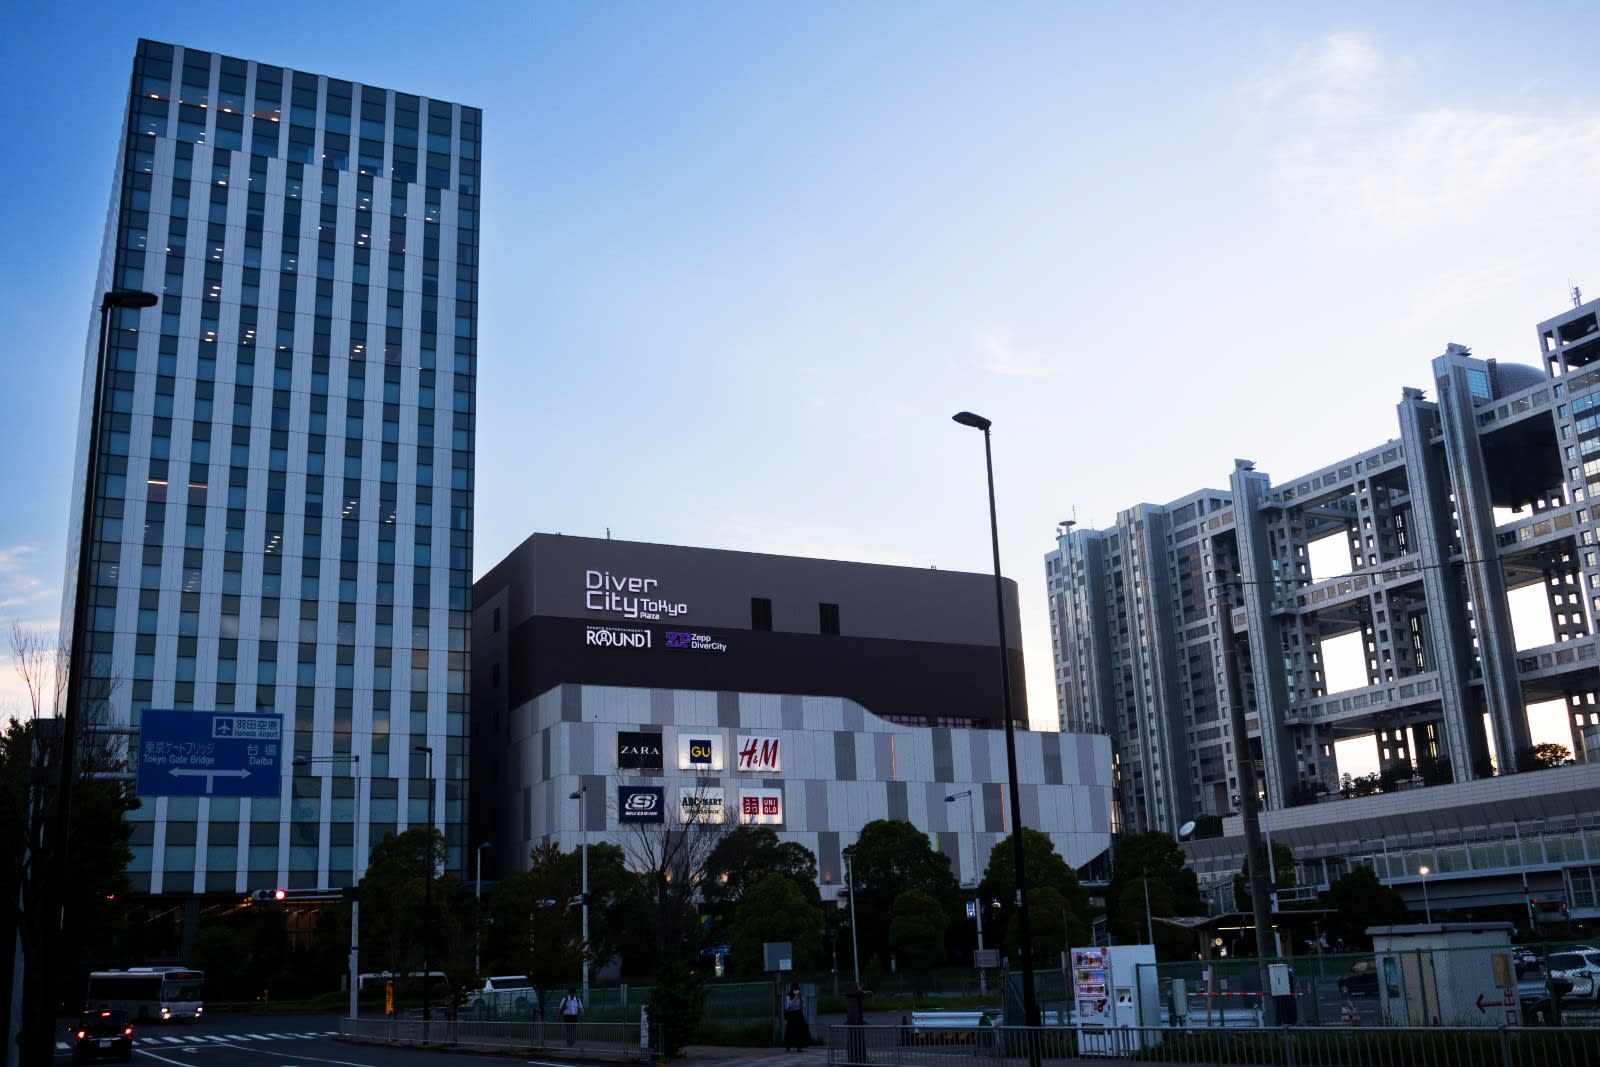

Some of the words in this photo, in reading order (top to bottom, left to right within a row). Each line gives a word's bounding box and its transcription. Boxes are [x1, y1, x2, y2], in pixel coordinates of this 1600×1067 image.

[586, 570, 657, 593] Diver
[586, 590, 637, 618] City
[640, 598, 687, 617] Tokyo
[640, 611, 660, 620] Plaza
[691, 633, 711, 643] Zepp
[691, 641, 727, 652] DiverCity
[236, 719, 278, 730] 羽田空港
[144, 741, 215, 755] 東京ゲートブリッジ
[620, 745, 660, 755] ZARA
[691, 745, 711, 758] GU
[739, 738, 779, 768] H&M
[144, 754, 167, 765] Tokyo
[169, 754, 188, 764] Gate
[190, 755, 215, 766] Bridge
[249, 756, 273, 766] Daiba
